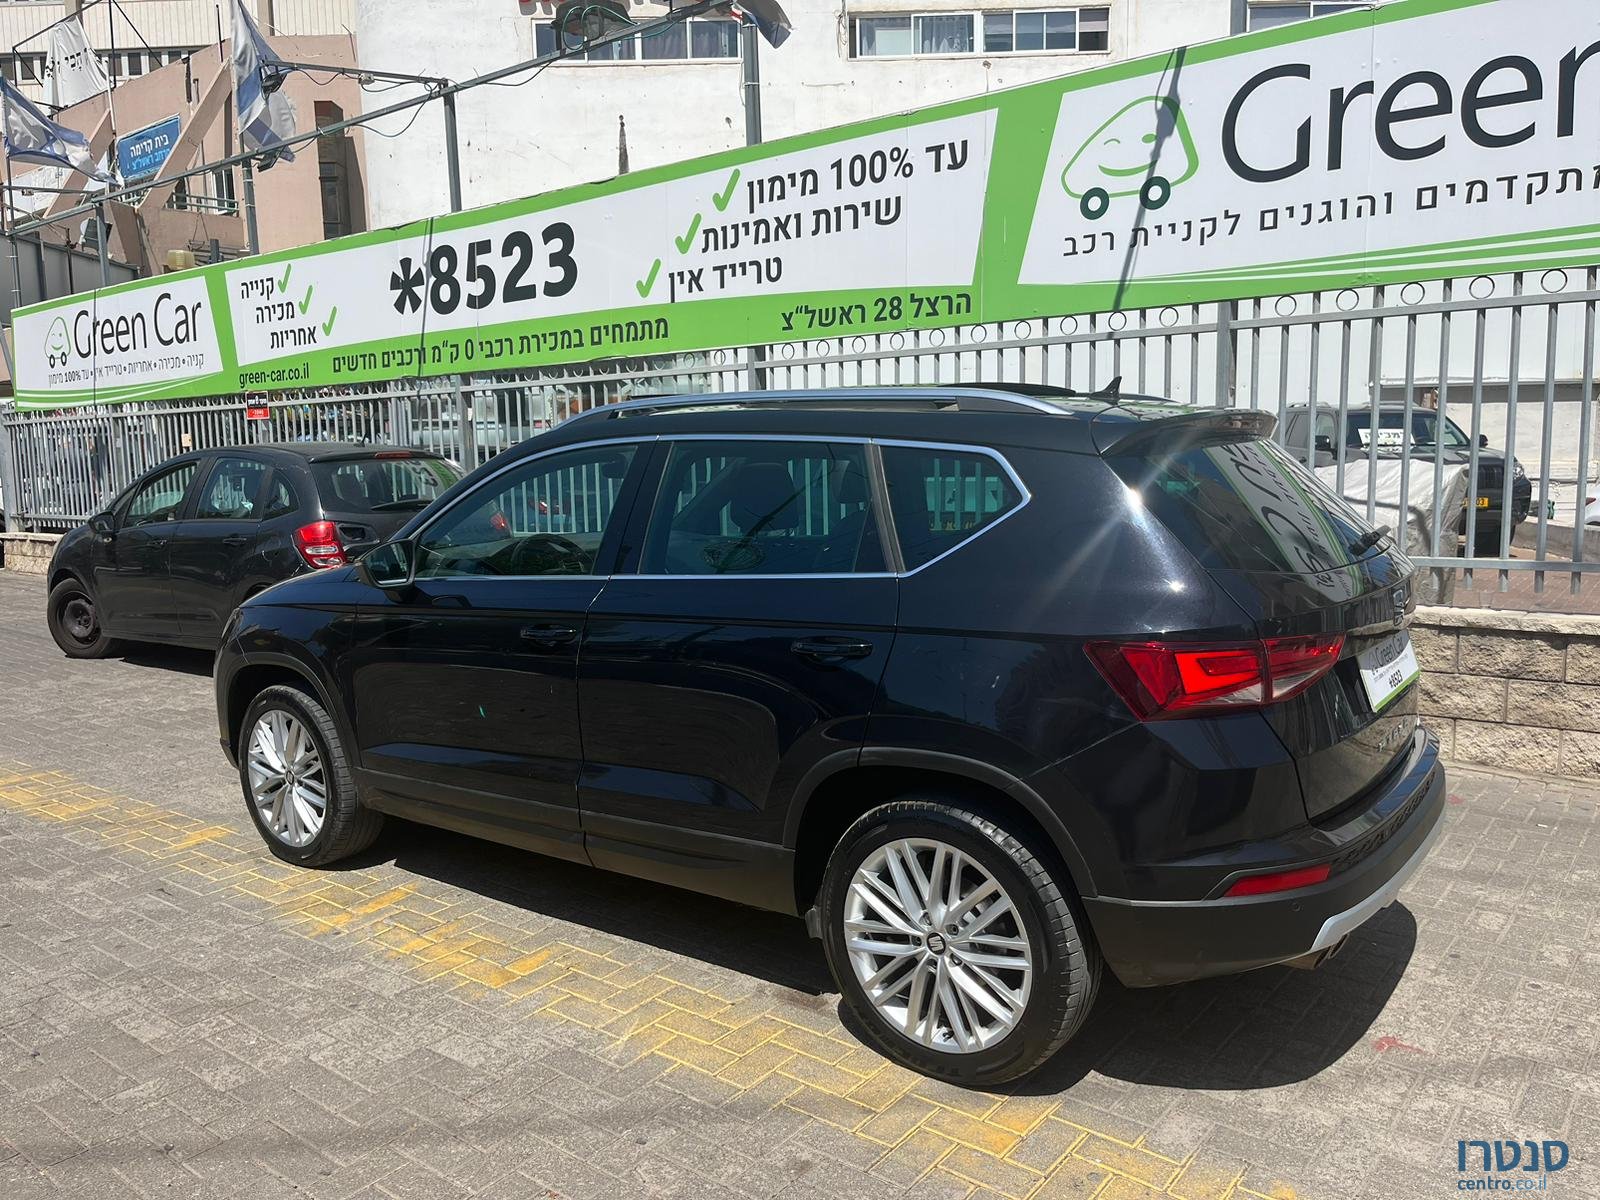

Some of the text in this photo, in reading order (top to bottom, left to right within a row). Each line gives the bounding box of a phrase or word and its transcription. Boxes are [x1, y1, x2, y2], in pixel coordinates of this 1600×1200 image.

[1221, 39, 1600, 183] Green
[130, 134, 169, 158] בית קדימה
[747, 139, 969, 214] עד 100% מימון
[1260, 187, 1393, 232] והוגנים
[701, 195, 902, 254] שירות ואמינות
[1131, 208, 1241, 248] לקניית
[1063, 230, 1116, 257] רכב
[240, 276, 275, 300] קנייה
[668, 256, 783, 303] טרייד אין
[255, 301, 296, 324] מכירה
[874, 295, 903, 322] 28
[911, 291, 972, 319] הרצל
[74, 292, 202, 359] Green Car
[270, 325, 318, 349] אחריות
[590, 317, 669, 346] מתמחים
[465, 338, 474, 360] 0
[478, 336, 514, 359] רכבי
[518, 327, 585, 355] במכירת
[332, 351, 377, 374] חדשים
[381, 346, 427, 368] ורכבים
[239, 362, 310, 388] green-car.co.il
